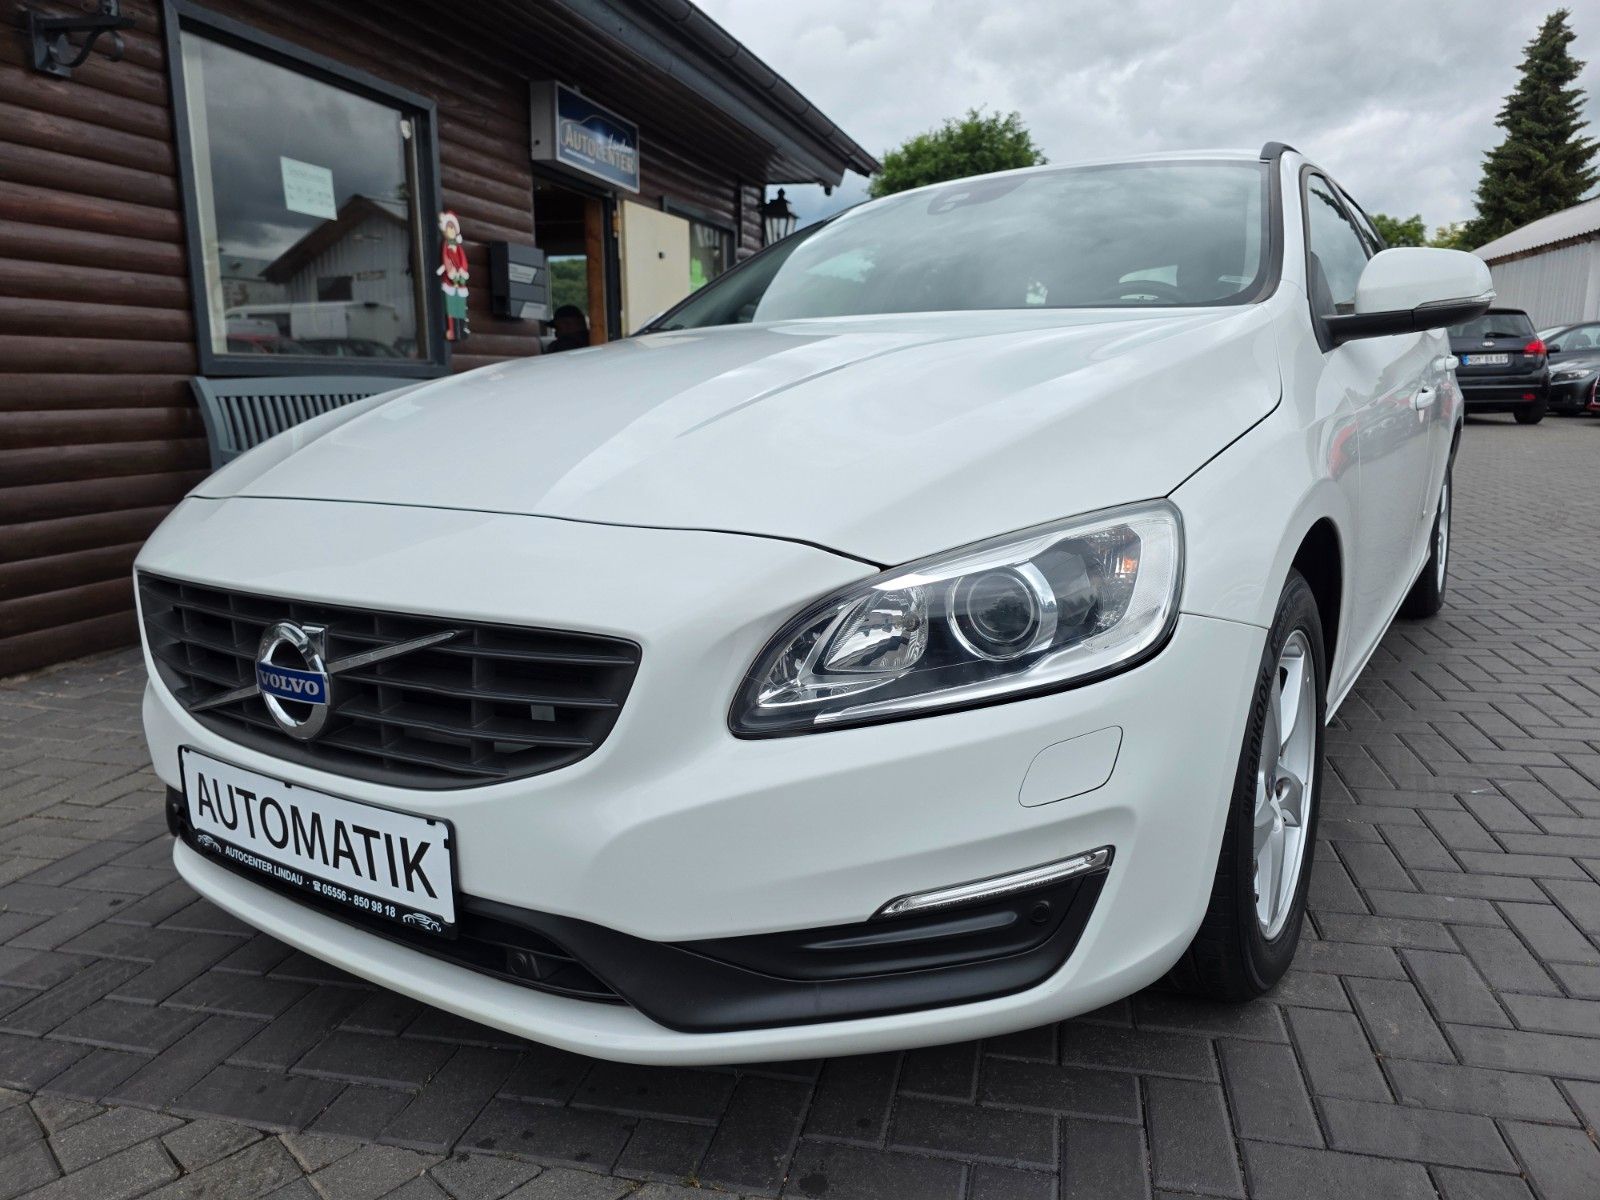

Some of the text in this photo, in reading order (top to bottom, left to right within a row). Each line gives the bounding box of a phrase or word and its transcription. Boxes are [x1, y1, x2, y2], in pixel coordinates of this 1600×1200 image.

[259, 670, 320, 696] VOLVO
[198, 772, 439, 899] AUTOMATIK
[225, 845, 273, 874] AUTOCENTER
[273, 865, 303, 885] LINDAU
[322, 883, 347, 901] 05556
[353, 894, 370, 909] 850
[371, 900, 382, 913] 98
[384, 904, 396, 918] 18
